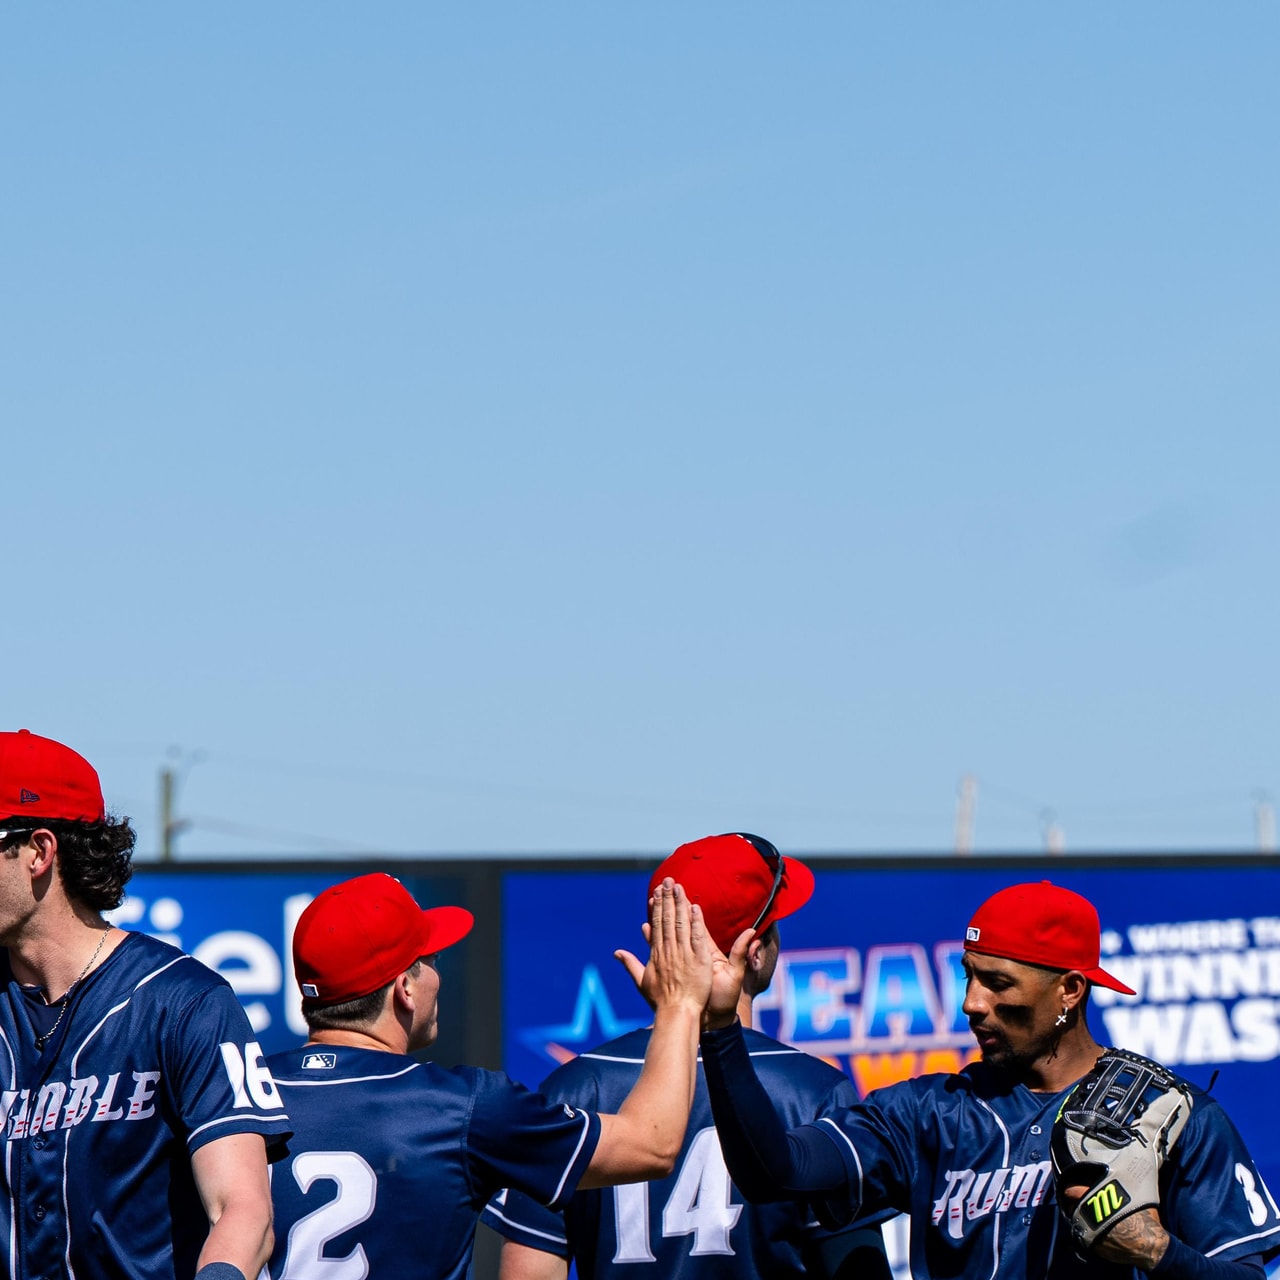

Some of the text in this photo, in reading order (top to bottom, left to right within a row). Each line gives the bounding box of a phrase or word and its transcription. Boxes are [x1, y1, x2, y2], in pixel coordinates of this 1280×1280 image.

[1128, 919, 1249, 951] WHERE
[220, 1041, 284, 1110] 16
[612, 1127, 744, 1264] 14
